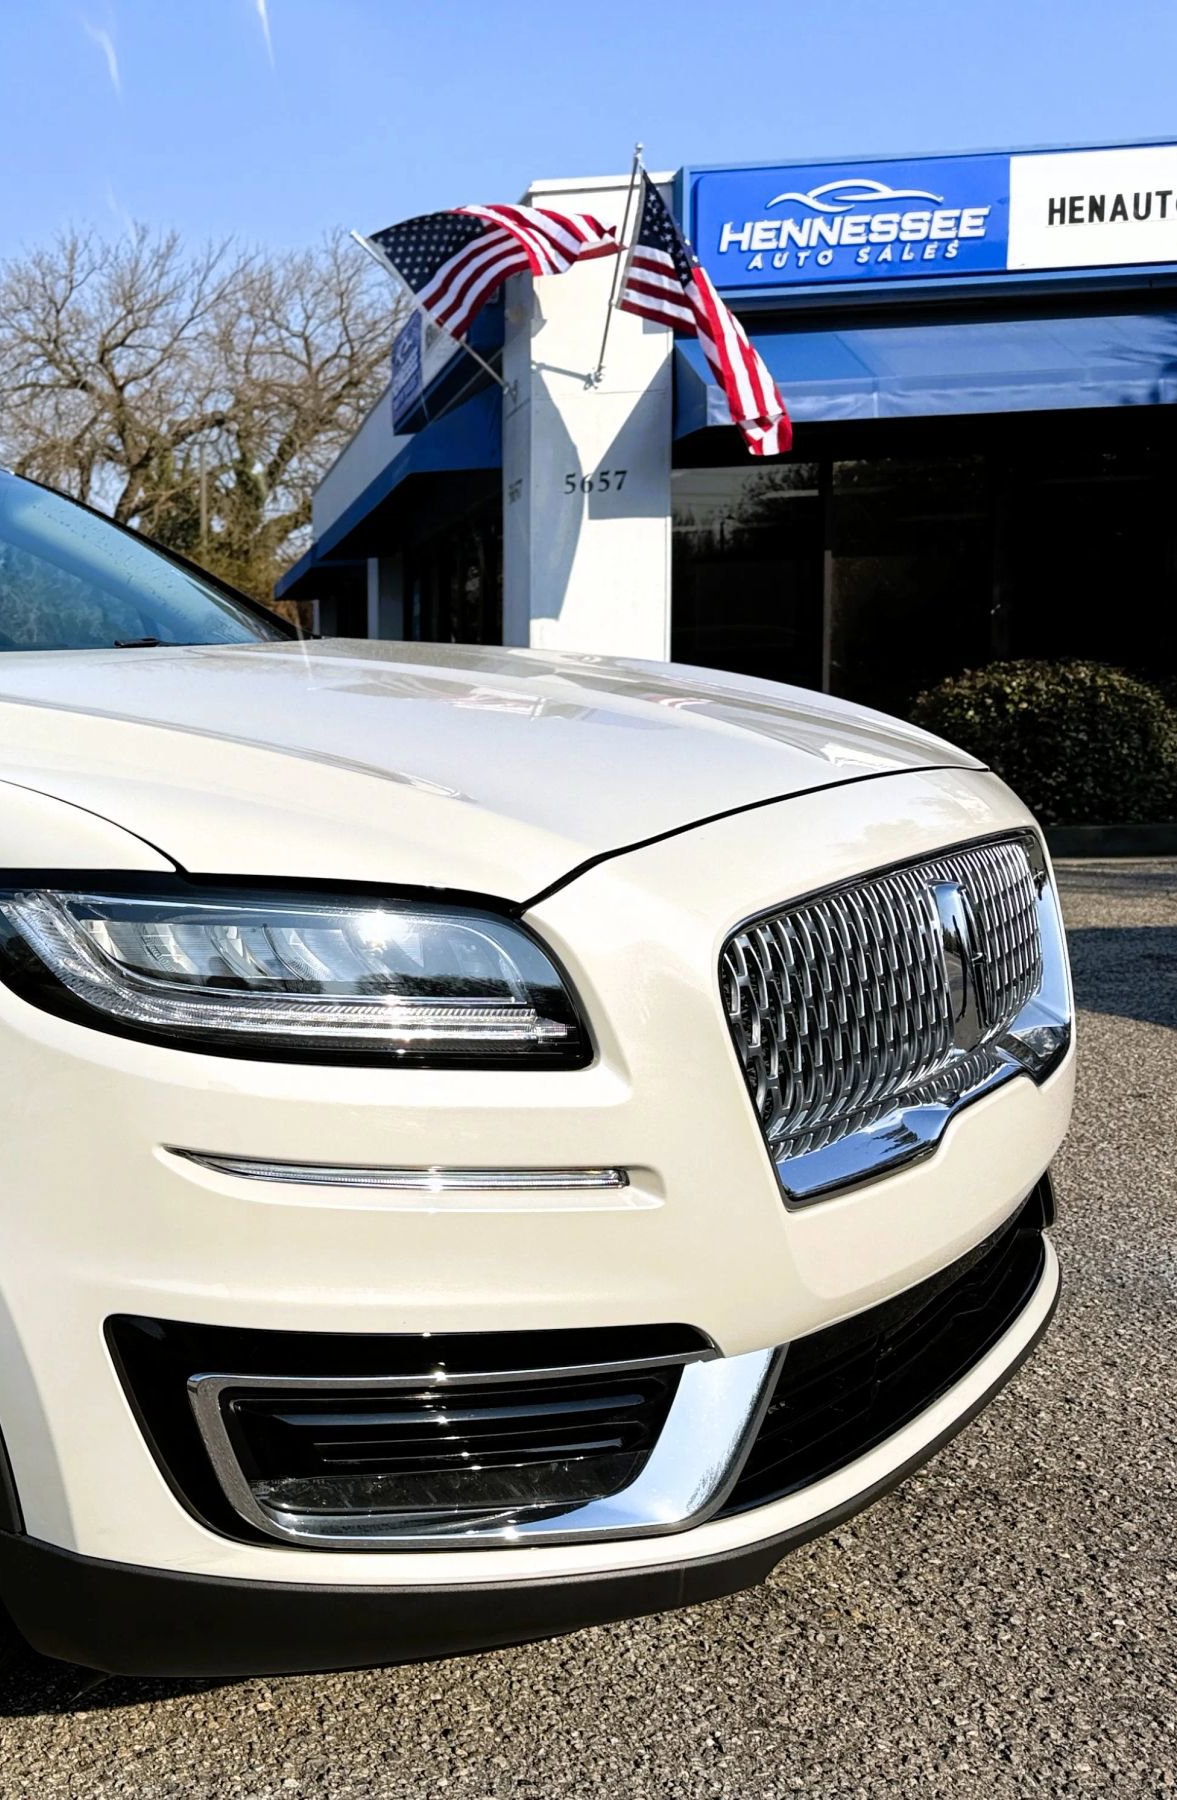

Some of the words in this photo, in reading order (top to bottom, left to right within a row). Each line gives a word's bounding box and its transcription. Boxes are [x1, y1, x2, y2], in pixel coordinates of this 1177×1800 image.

[1047, 190, 1177, 226] HENAUT
[719, 205, 990, 252] HENNESSEE
[747, 250, 834, 271] AUTO
[856, 240, 960, 264] SALES
[563, 470, 628, 495] 5657
